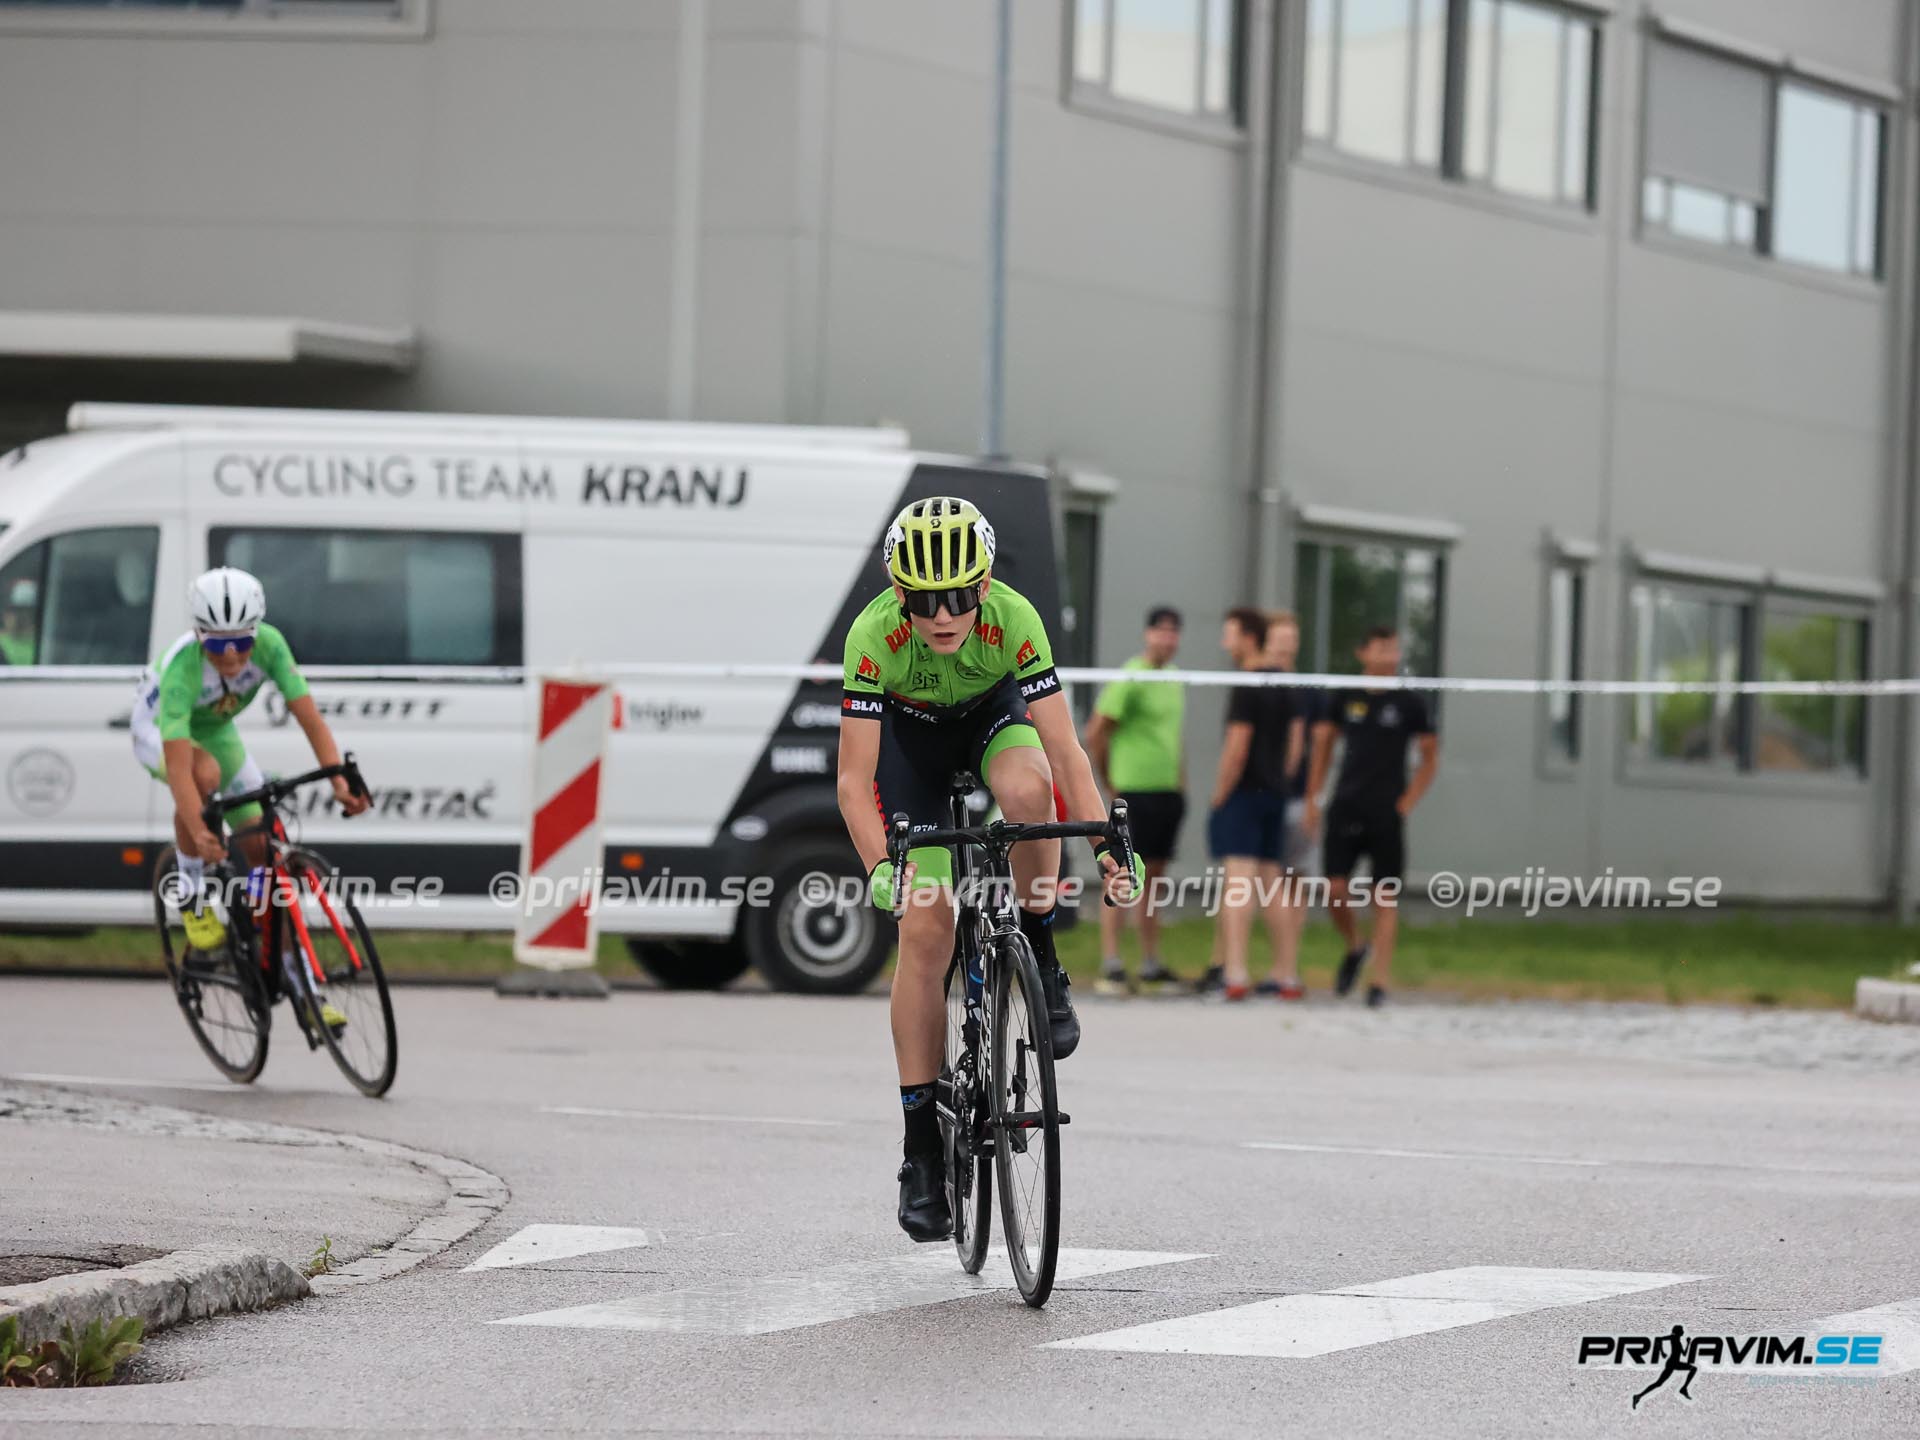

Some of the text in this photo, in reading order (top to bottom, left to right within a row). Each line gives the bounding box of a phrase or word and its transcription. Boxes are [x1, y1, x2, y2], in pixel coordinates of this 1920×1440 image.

[213, 454, 749, 507] CYCLING TEAM KRANJ
[1021, 675, 1057, 697] BLAK
